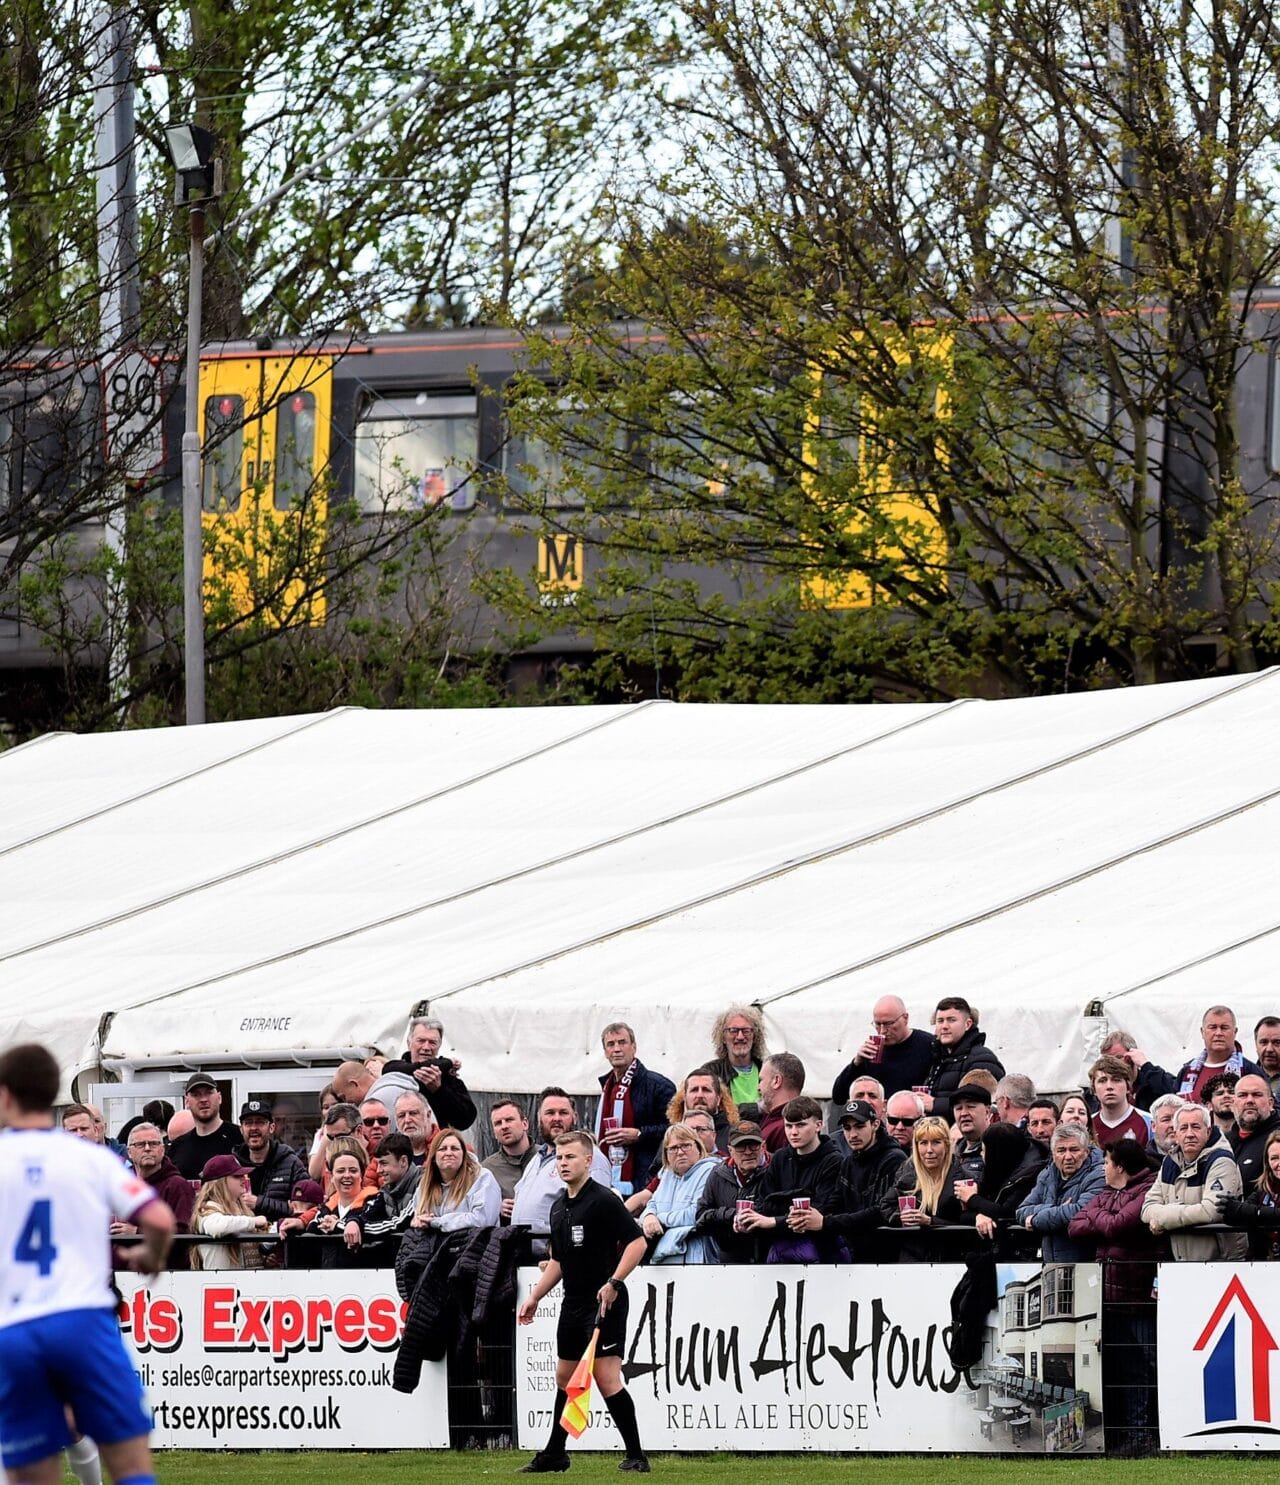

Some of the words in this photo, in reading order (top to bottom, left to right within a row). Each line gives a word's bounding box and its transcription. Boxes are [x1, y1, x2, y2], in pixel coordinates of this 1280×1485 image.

[113, 374, 155, 416] 80
[544, 536, 578, 581] M
[240, 1017, 291, 1031] ENTRANCE
[14, 1198, 58, 1278] 4
[533, 1302, 556, 1318] and
[527, 1336, 554, 1352] Ferry
[622, 1281, 744, 1401] Alum
[526, 1354, 557, 1372] South
[161, 1363, 392, 1392] sales@carpartsexpress.co.uk
[527, 1376, 555, 1392] NE33
[666, 1404, 727, 1429] REAL
[735, 1404, 778, 1429] ALE
[787, 1404, 869, 1429] HOUSE
